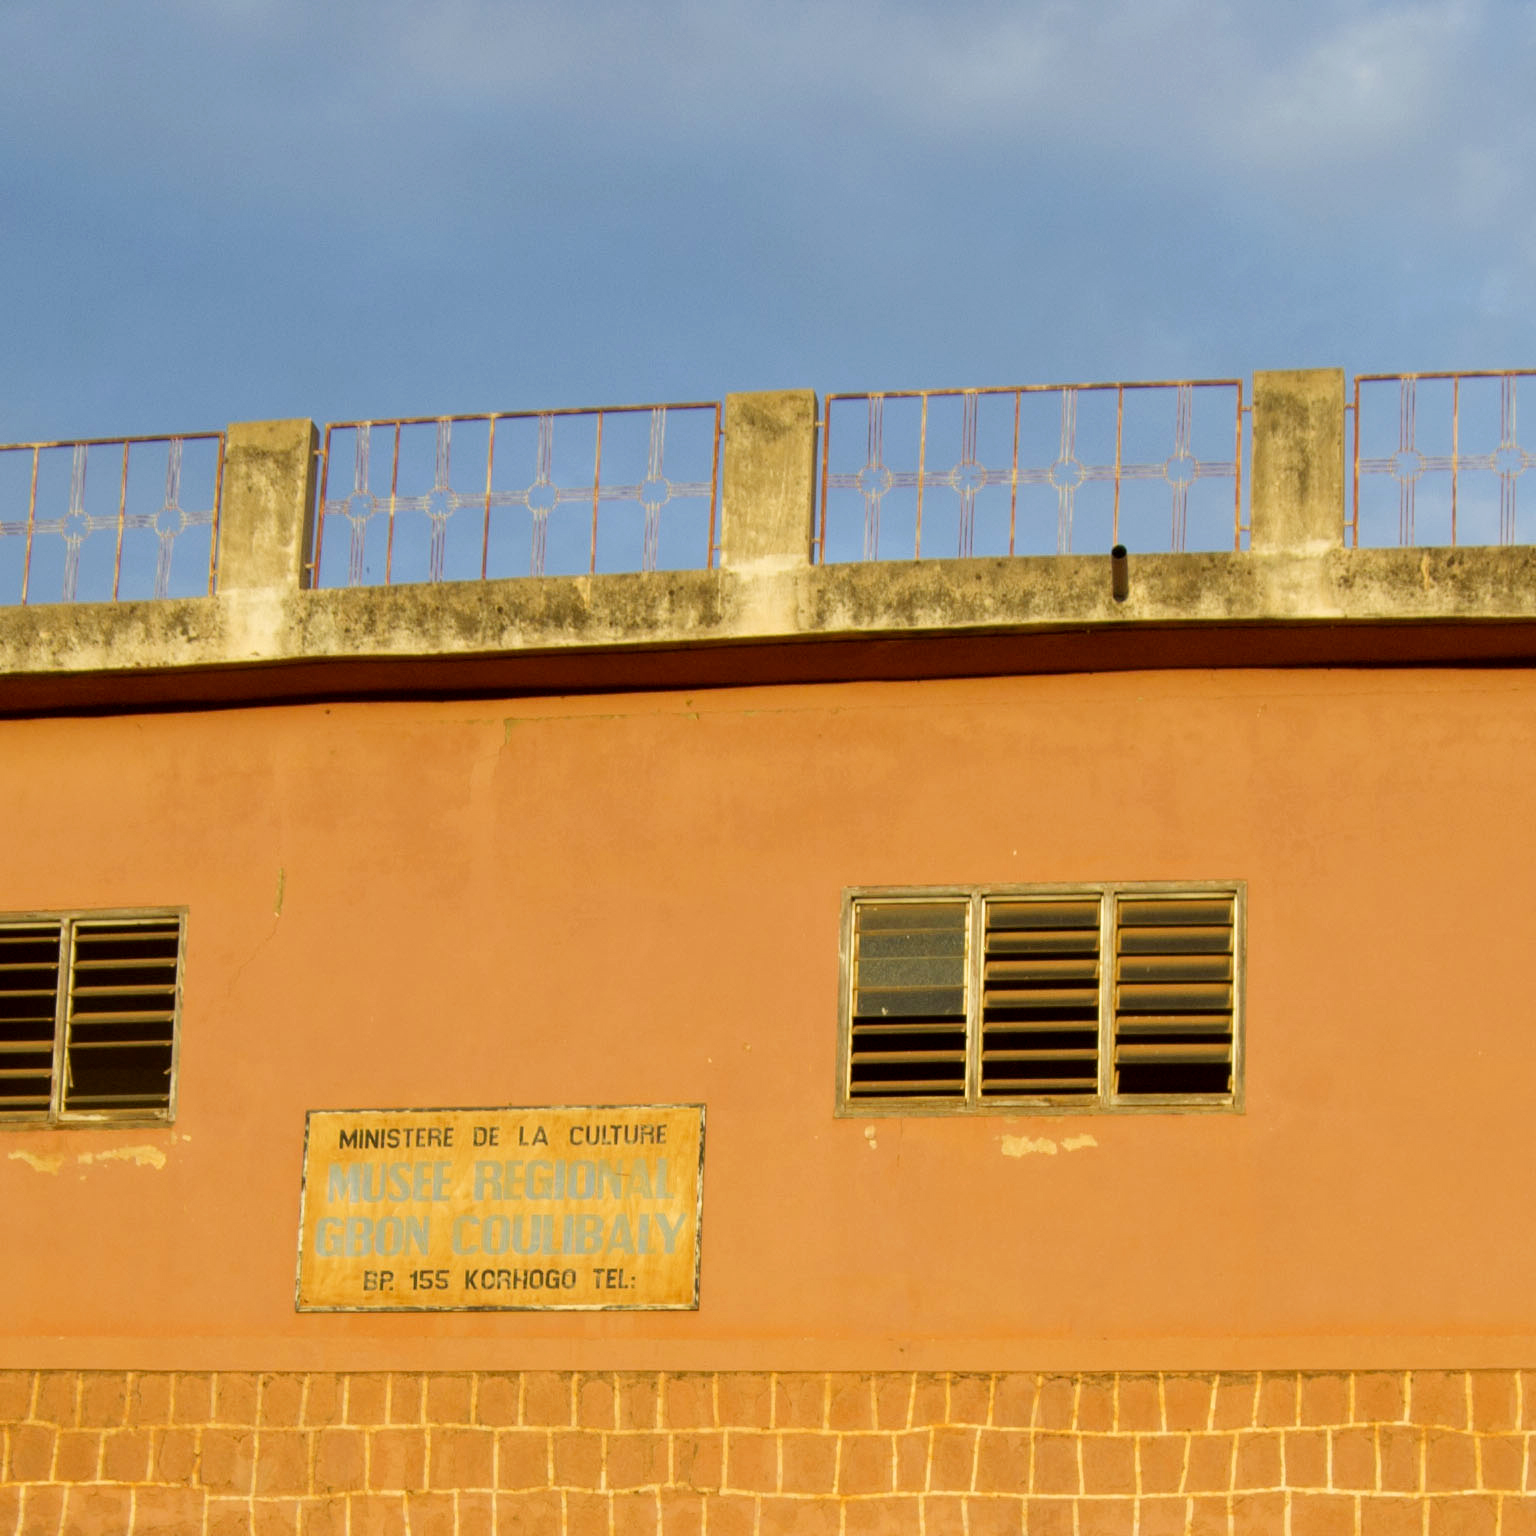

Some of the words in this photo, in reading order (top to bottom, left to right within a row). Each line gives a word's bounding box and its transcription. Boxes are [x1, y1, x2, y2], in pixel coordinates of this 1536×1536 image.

[340, 1128, 454, 1149] MINISTERE
[473, 1127, 500, 1146] DE
[518, 1126, 548, 1146] LA
[570, 1124, 667, 1146] CULTURE
[327, 1160, 452, 1203] MUSEE
[474, 1157, 674, 1201] REGIONAL
[314, 1216, 430, 1256] GBON
[452, 1212, 686, 1256] COULIBALY
[410, 1269, 450, 1290] 155
[464, 1269, 576, 1290] KORHOGO
